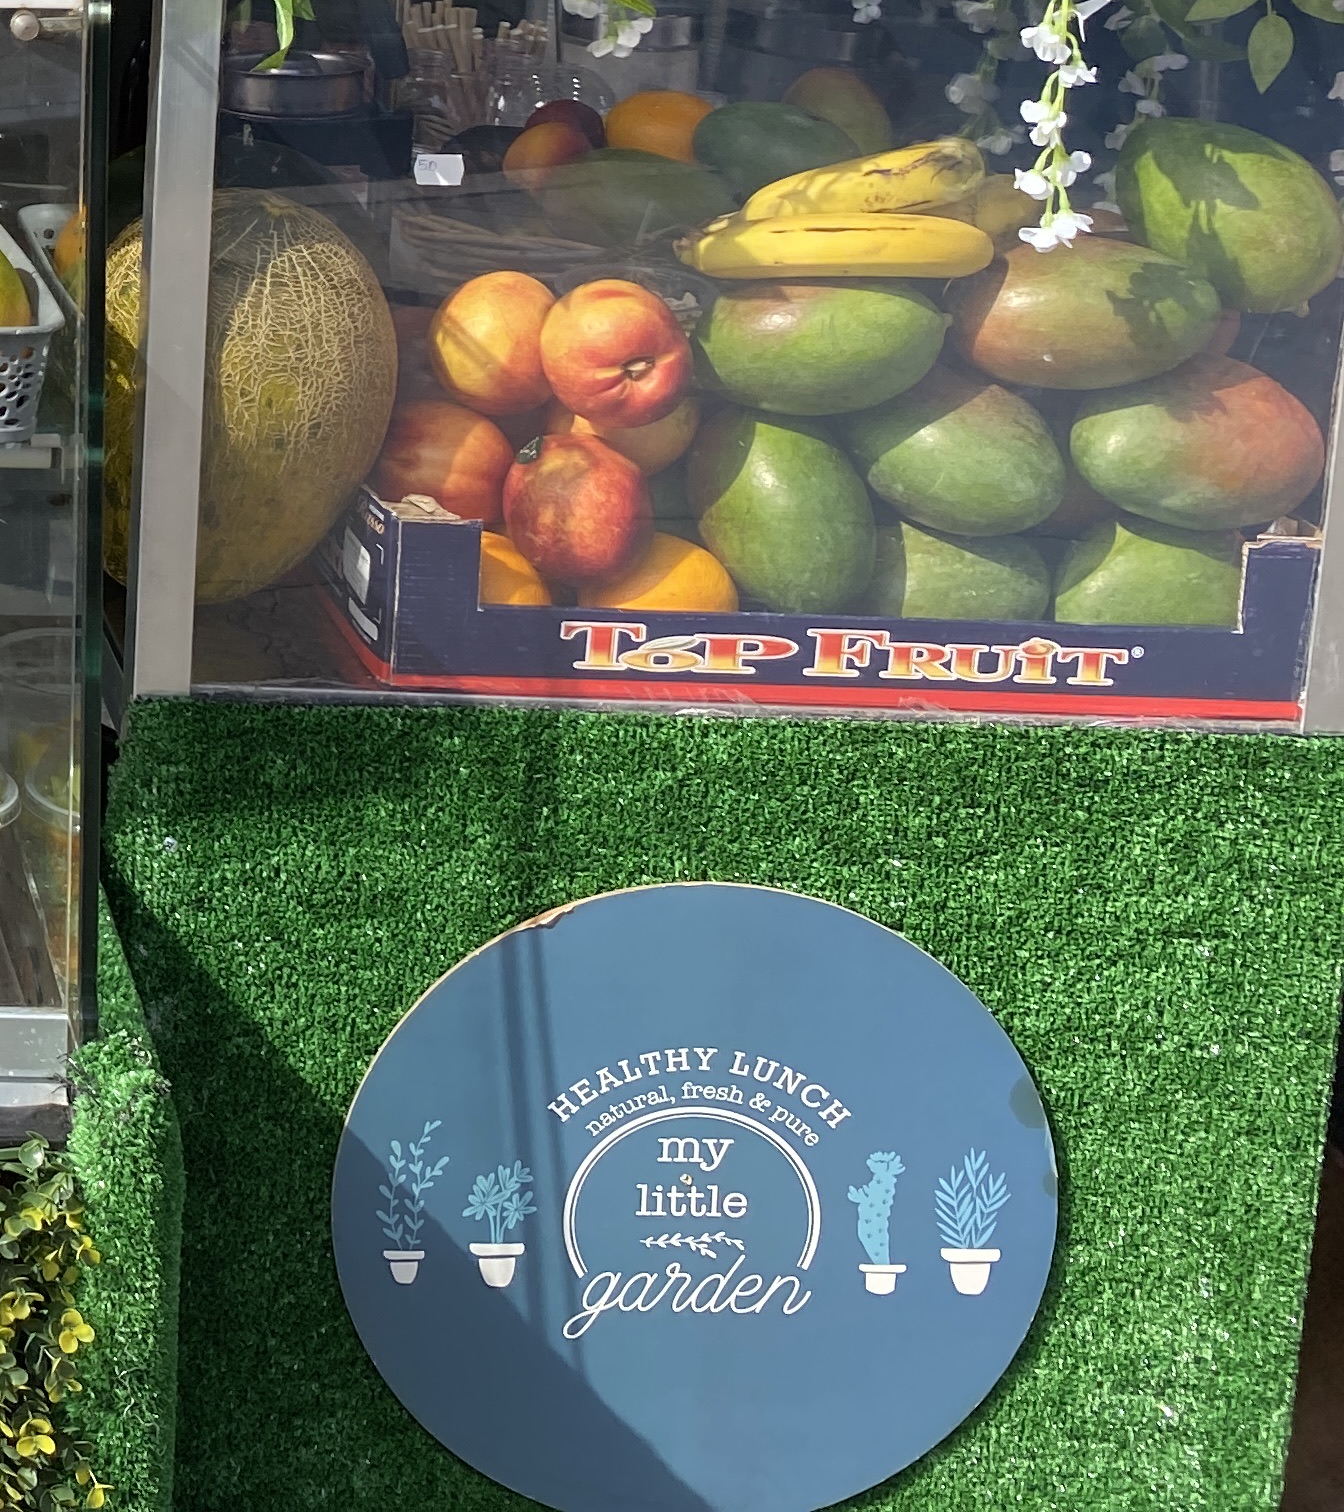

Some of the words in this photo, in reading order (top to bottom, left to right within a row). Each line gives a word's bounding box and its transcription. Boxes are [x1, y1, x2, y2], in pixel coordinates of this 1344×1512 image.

[547, 1047, 718, 1123] HEALTHY
[732, 1050, 852, 1130] LUNCH
[585, 1084, 676, 1138] natural,
[681, 1081, 744, 1105] fresh
[749, 1091, 772, 1113] &
[768, 1104, 821, 1148] pure
[657, 1135, 735, 1172] my
[635, 1183, 748, 1219] little
[562, 1254, 813, 1340] garden
